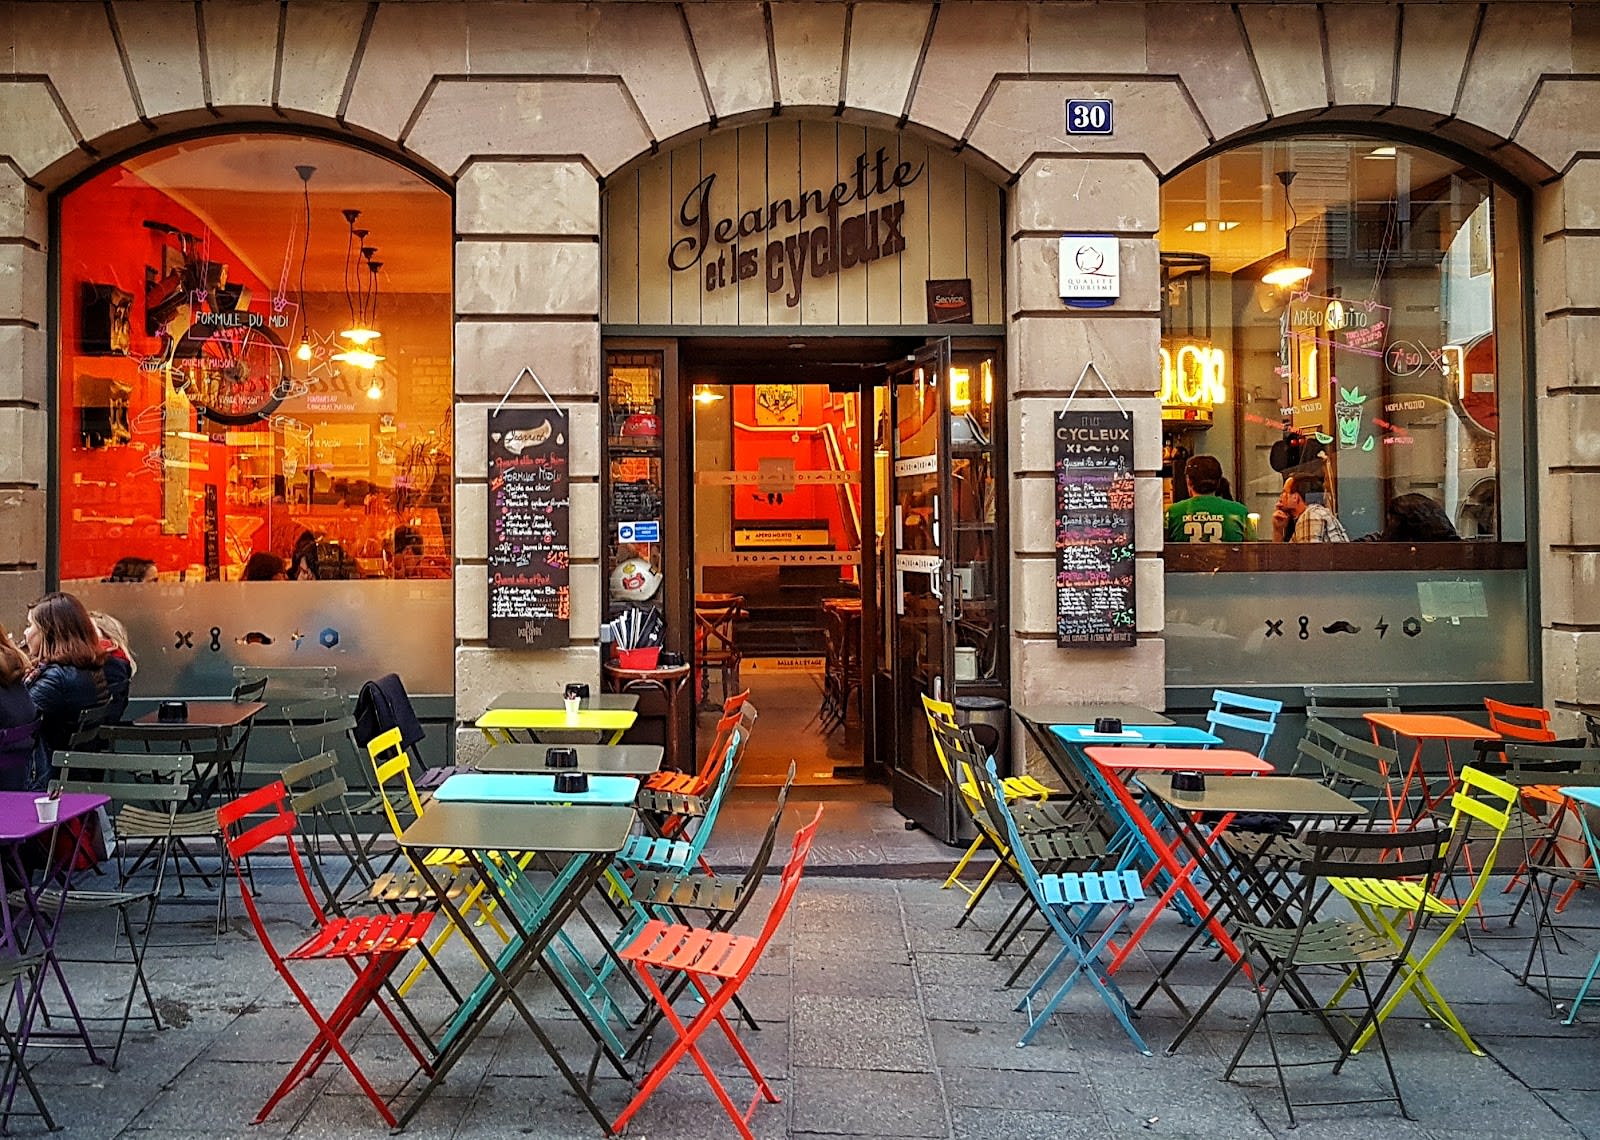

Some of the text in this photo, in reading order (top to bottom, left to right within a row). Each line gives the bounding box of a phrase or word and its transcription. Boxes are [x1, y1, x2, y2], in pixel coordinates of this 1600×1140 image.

[1074, 105, 1106, 128] 30
[668, 147, 925, 271] Jeannette
[705, 250, 726, 293] et
[195, 311, 289, 328] FORMULE DU MIDI
[1057, 427, 1130, 441] CYCLEUX
